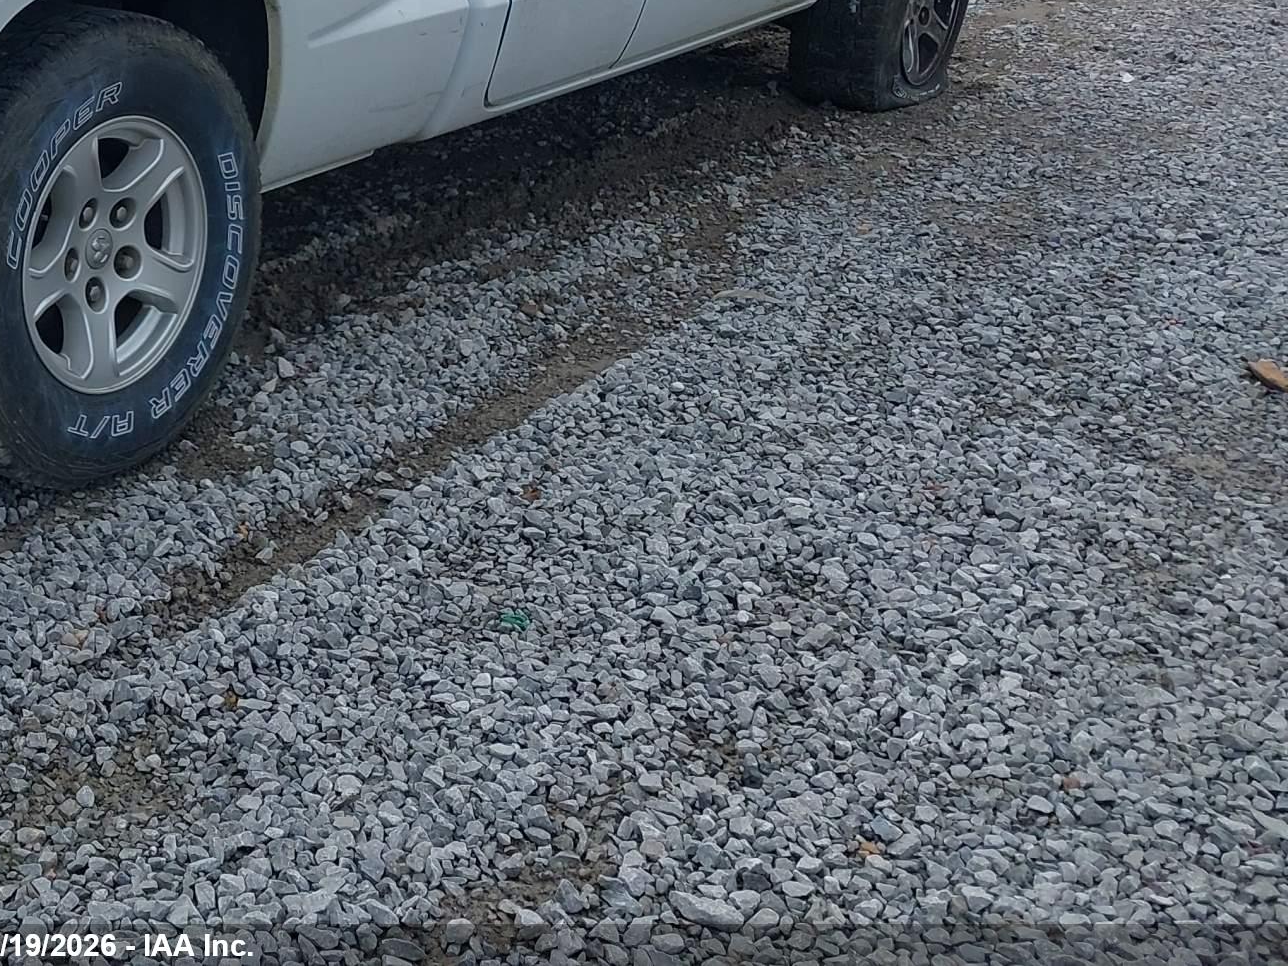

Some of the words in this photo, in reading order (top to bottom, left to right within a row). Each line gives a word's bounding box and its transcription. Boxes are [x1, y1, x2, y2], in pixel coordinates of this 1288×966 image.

[7, 82, 122, 270] COOPER
[149, 152, 243, 419] DISCOVERER
[68, 411, 134, 438] A/T
